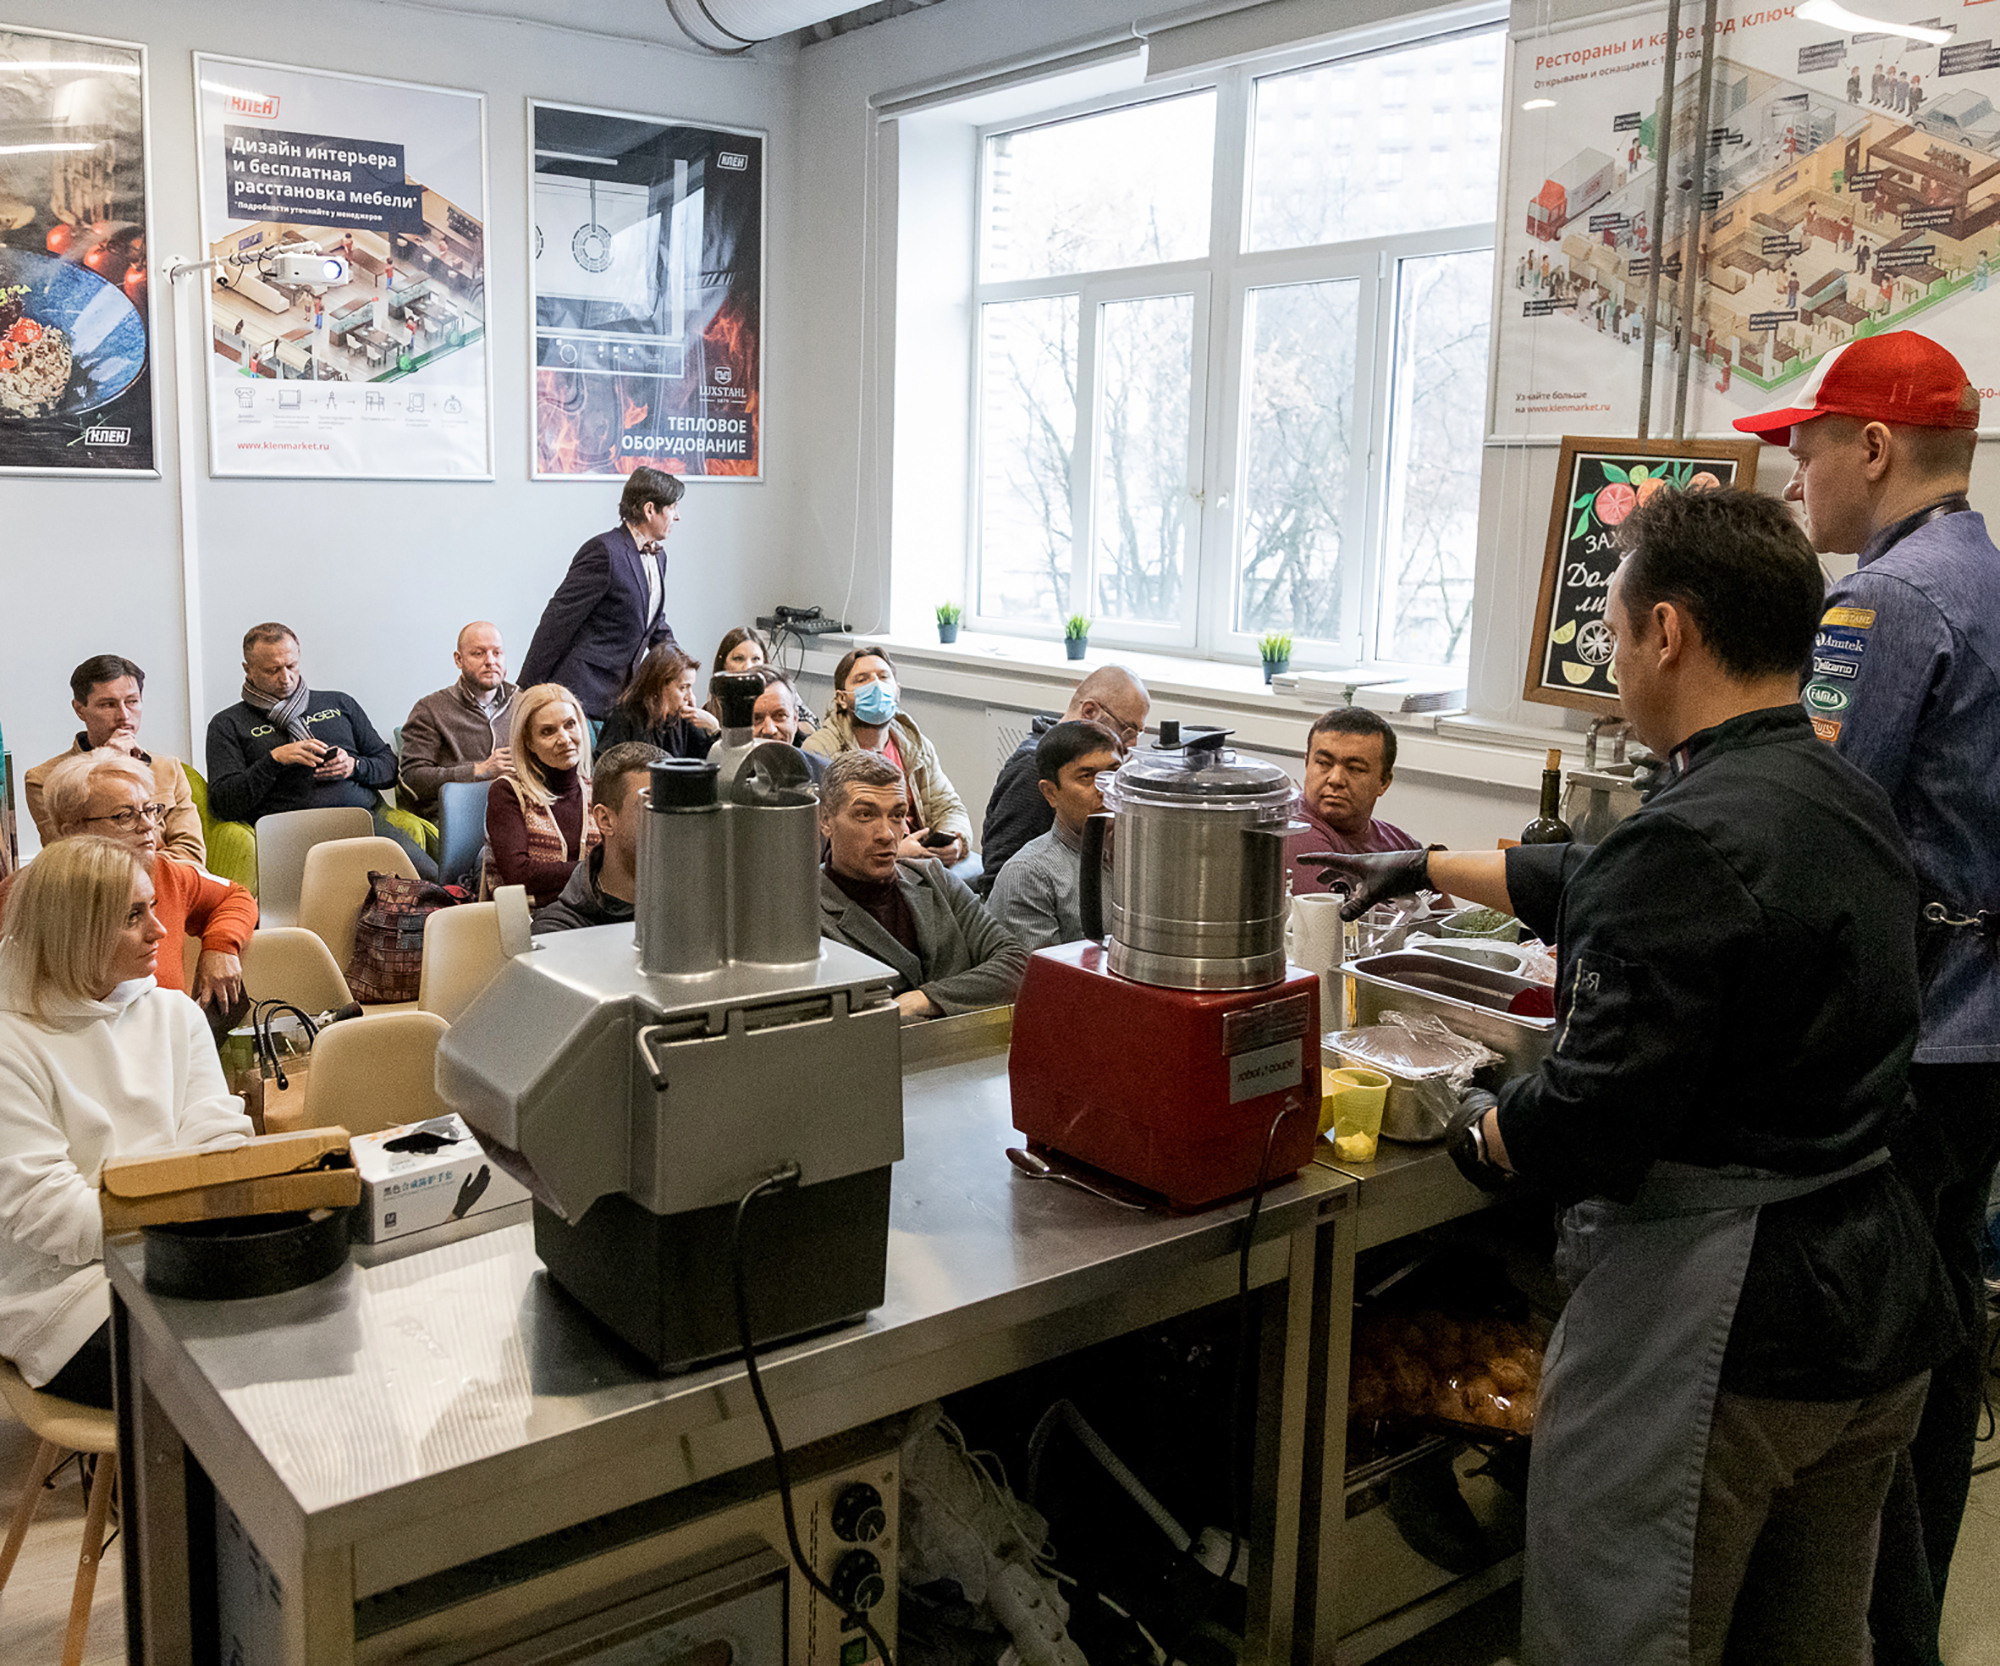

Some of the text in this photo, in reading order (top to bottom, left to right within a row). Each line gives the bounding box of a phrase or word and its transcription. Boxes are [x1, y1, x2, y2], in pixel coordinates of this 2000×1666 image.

[1535, 40, 1626, 70] Рестораны
[1632, 37, 1644, 49] и
[1742, 5, 1795, 28] ключ
[1534, 73, 1588, 89] Открываем
[1590, 70, 1597, 78] и
[1599, 60, 1649, 77] оснащаем
[1660, 52, 1682, 64] 13
[232, 137, 397, 170] Дизайн интерьера
[233, 159, 352, 183] и бесплатная
[234, 180, 346, 202] расстановка
[290, 206, 330, 217] уточняйте
[336, 211, 383, 221] менеджеров
[699, 385, 748, 398] LUXSTAHL
[1551, 390, 1588, 400] больше
[1979, 388, 2000, 399] 50-
[1527, 403, 1611, 413] www.klenmarket.ru
[667, 416, 747, 433] ТЕПЛОВОЕ
[90, 429, 126, 443] КЛЕН
[237, 441, 330, 451] www.klenmarket.ru
[621, 435, 747, 455] ОБОРУДОВАНИЕ
